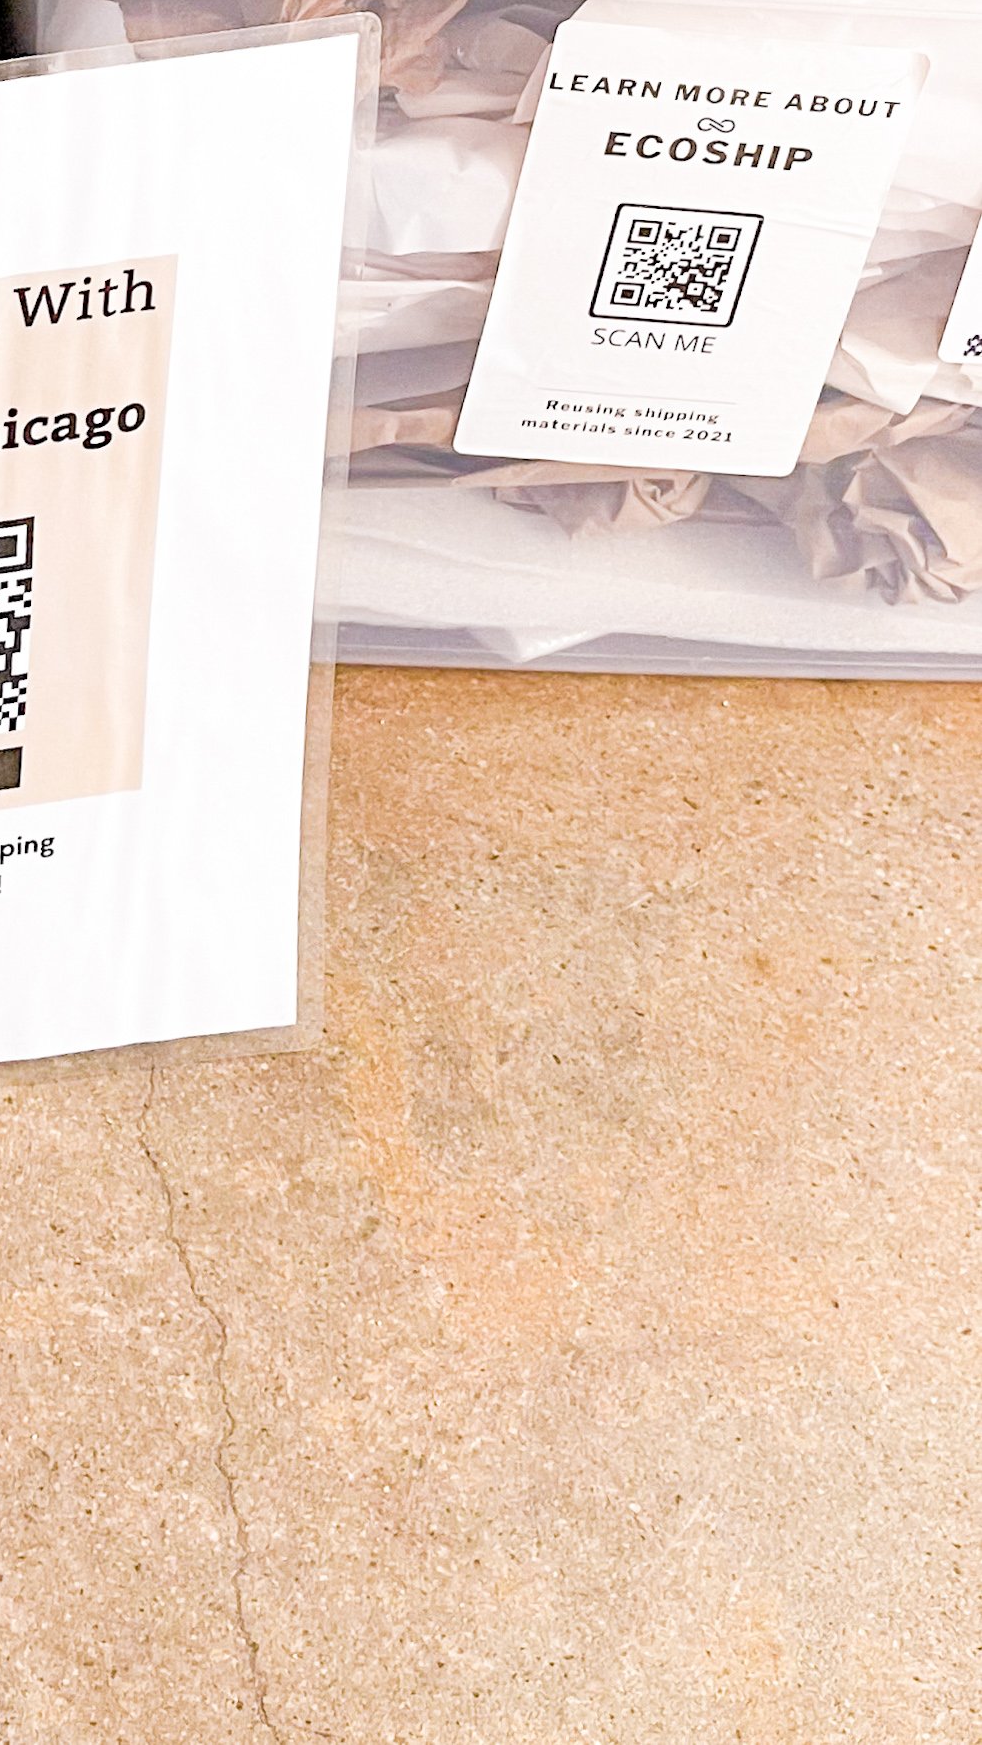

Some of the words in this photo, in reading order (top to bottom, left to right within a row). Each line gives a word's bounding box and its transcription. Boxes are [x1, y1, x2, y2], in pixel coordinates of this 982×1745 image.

[549, 72, 662, 99] LEARN
[674, 84, 772, 108] MORE
[784, 93, 901, 118] ABOUT
[604, 131, 813, 171] ECOSHIP
[13, 268, 156, 328] With
[591, 328, 666, 350] SCAN
[673, 334, 716, 354] ME
[546, 400, 626, 418] Reusing
[635, 407, 718, 424] shipping
[521, 419, 617, 434] materials
[625, 426, 675, 438] since
[683, 430, 732, 442] 2021
